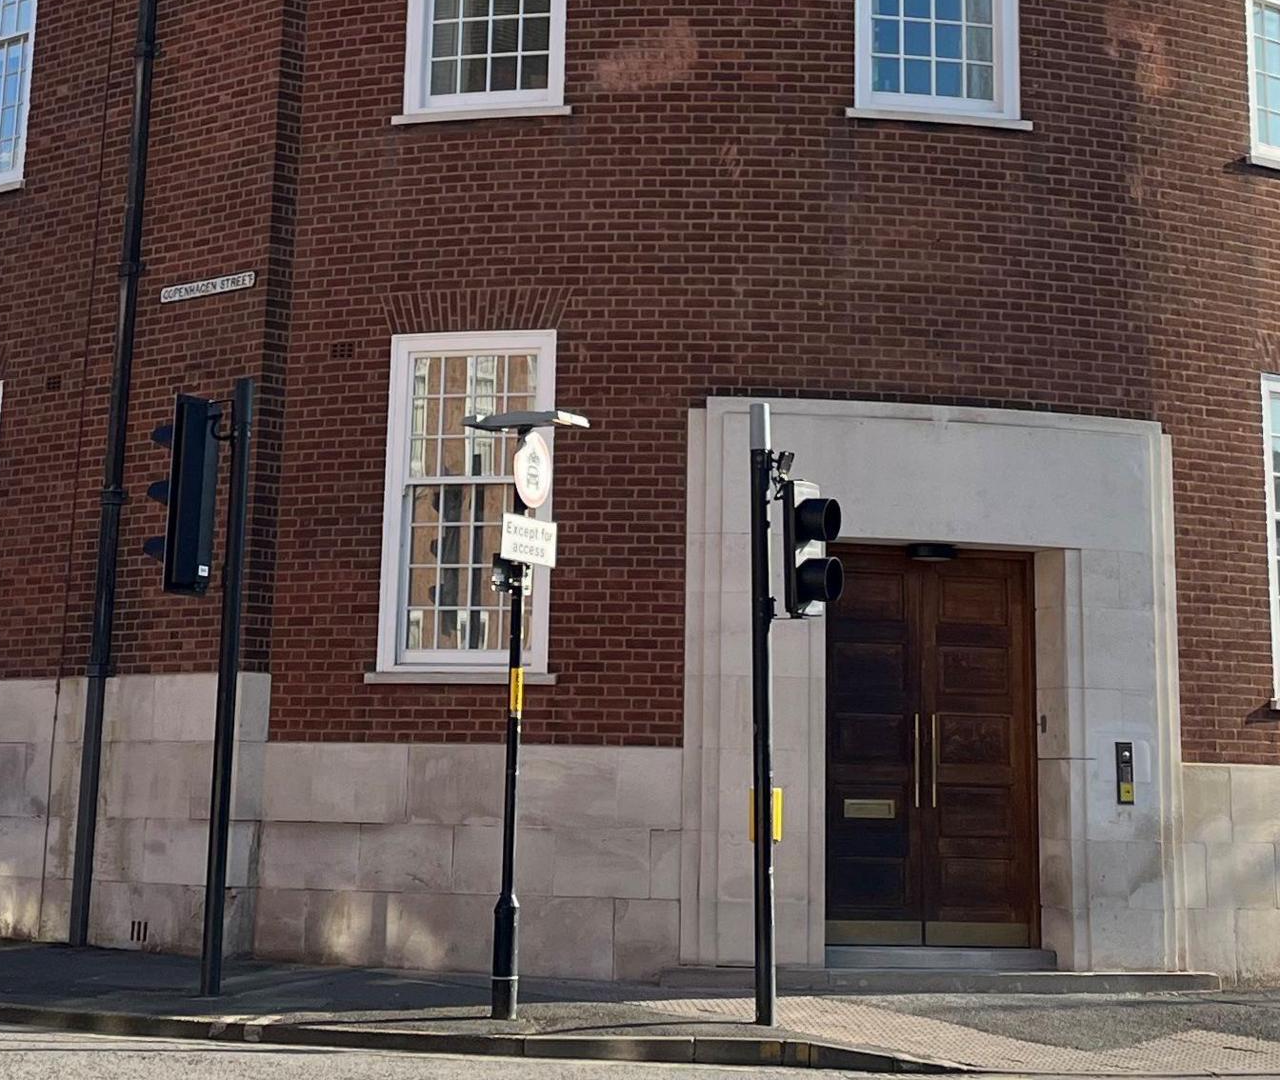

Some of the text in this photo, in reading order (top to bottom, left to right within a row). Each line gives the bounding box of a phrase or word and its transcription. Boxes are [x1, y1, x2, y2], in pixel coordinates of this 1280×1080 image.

[162, 273, 254, 300] COPENHAGEN STREET
[506, 521, 553, 541] Except for
[512, 542, 544, 558] access
